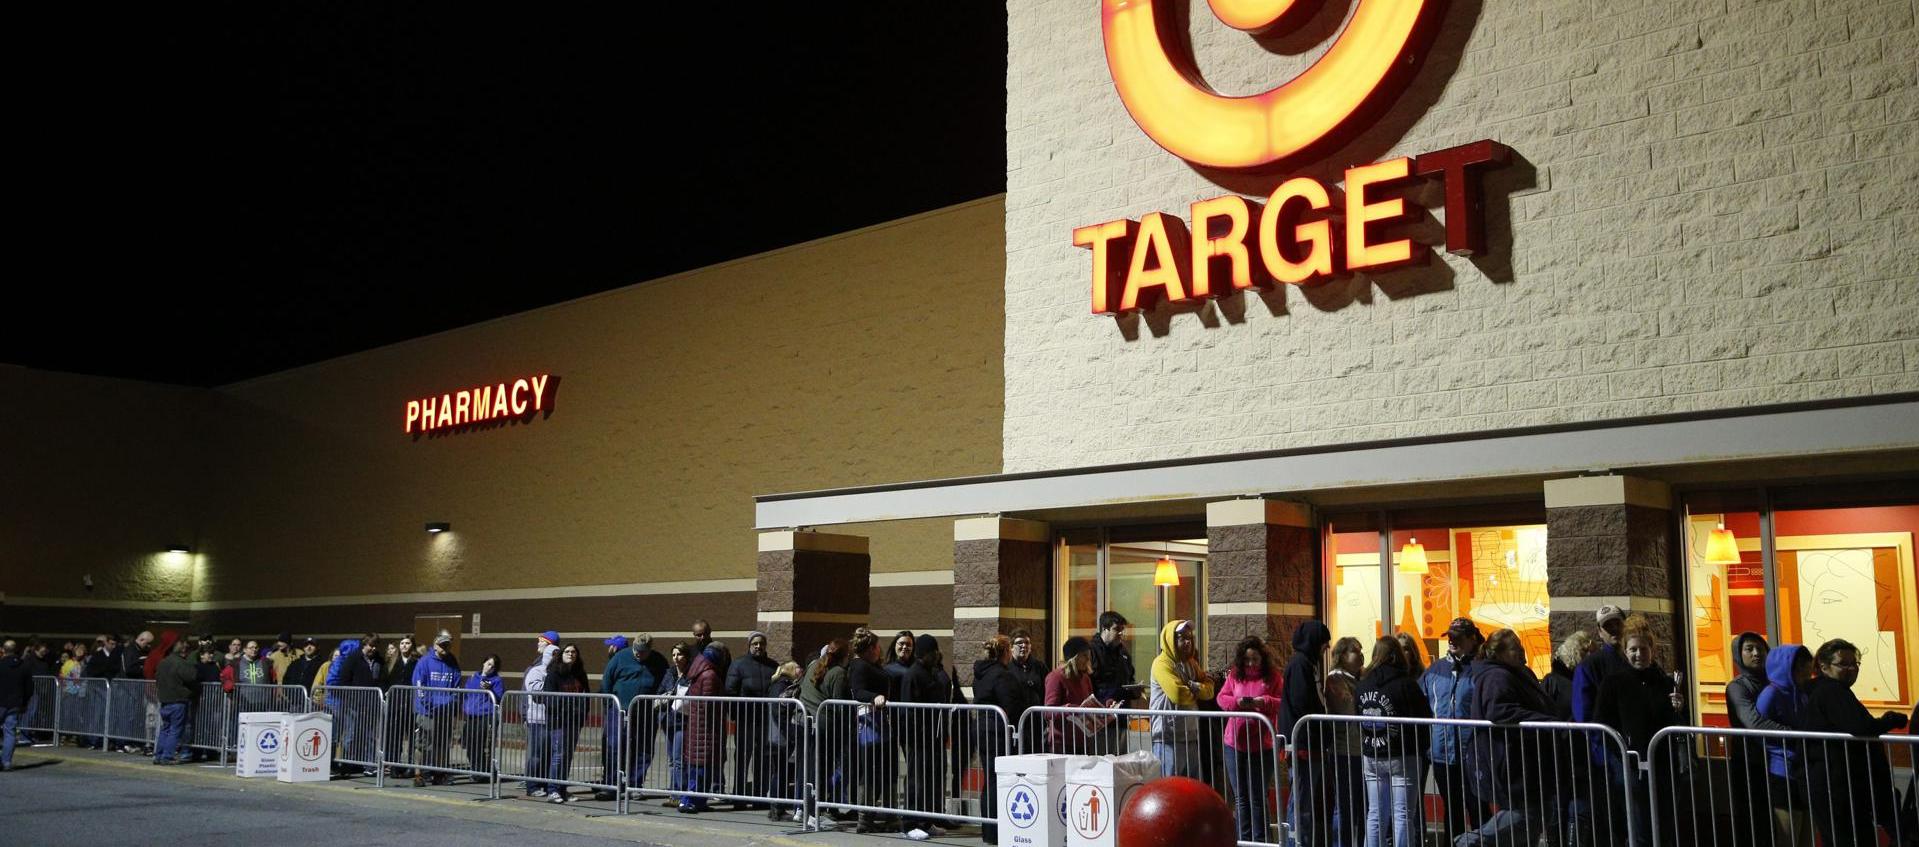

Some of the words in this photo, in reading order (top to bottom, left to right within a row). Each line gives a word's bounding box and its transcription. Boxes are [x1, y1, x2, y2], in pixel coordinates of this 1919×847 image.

[1073, 139, 1503, 314] TARGET
[405, 374, 549, 433] PHARMACY
[301, 765, 320, 774] Trash
[1013, 835, 1033, 844] Glass
